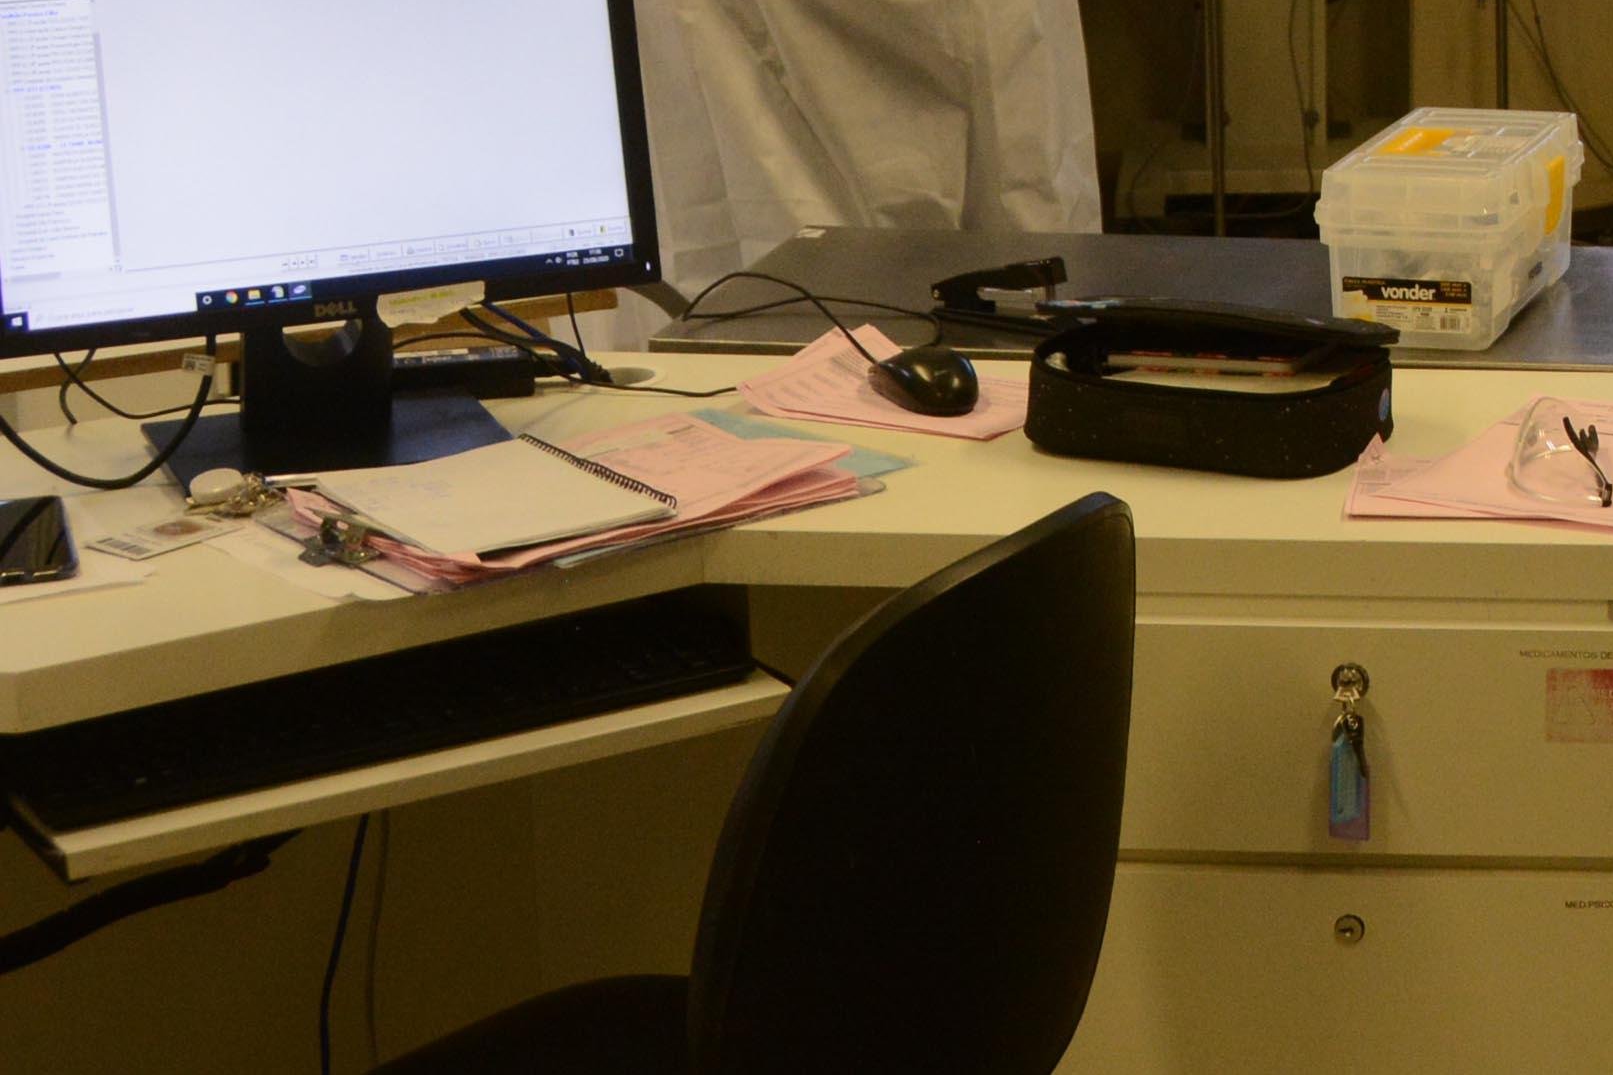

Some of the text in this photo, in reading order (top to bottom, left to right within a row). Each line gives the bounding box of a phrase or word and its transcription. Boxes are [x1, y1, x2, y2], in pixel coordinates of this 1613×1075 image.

[1381, 284, 1437, 300] vonder
[314, 301, 357, 317] DELL
[1519, 650, 1598, 659] MEDICAMENTOS
[1600, 651, 1613, 659] DE
